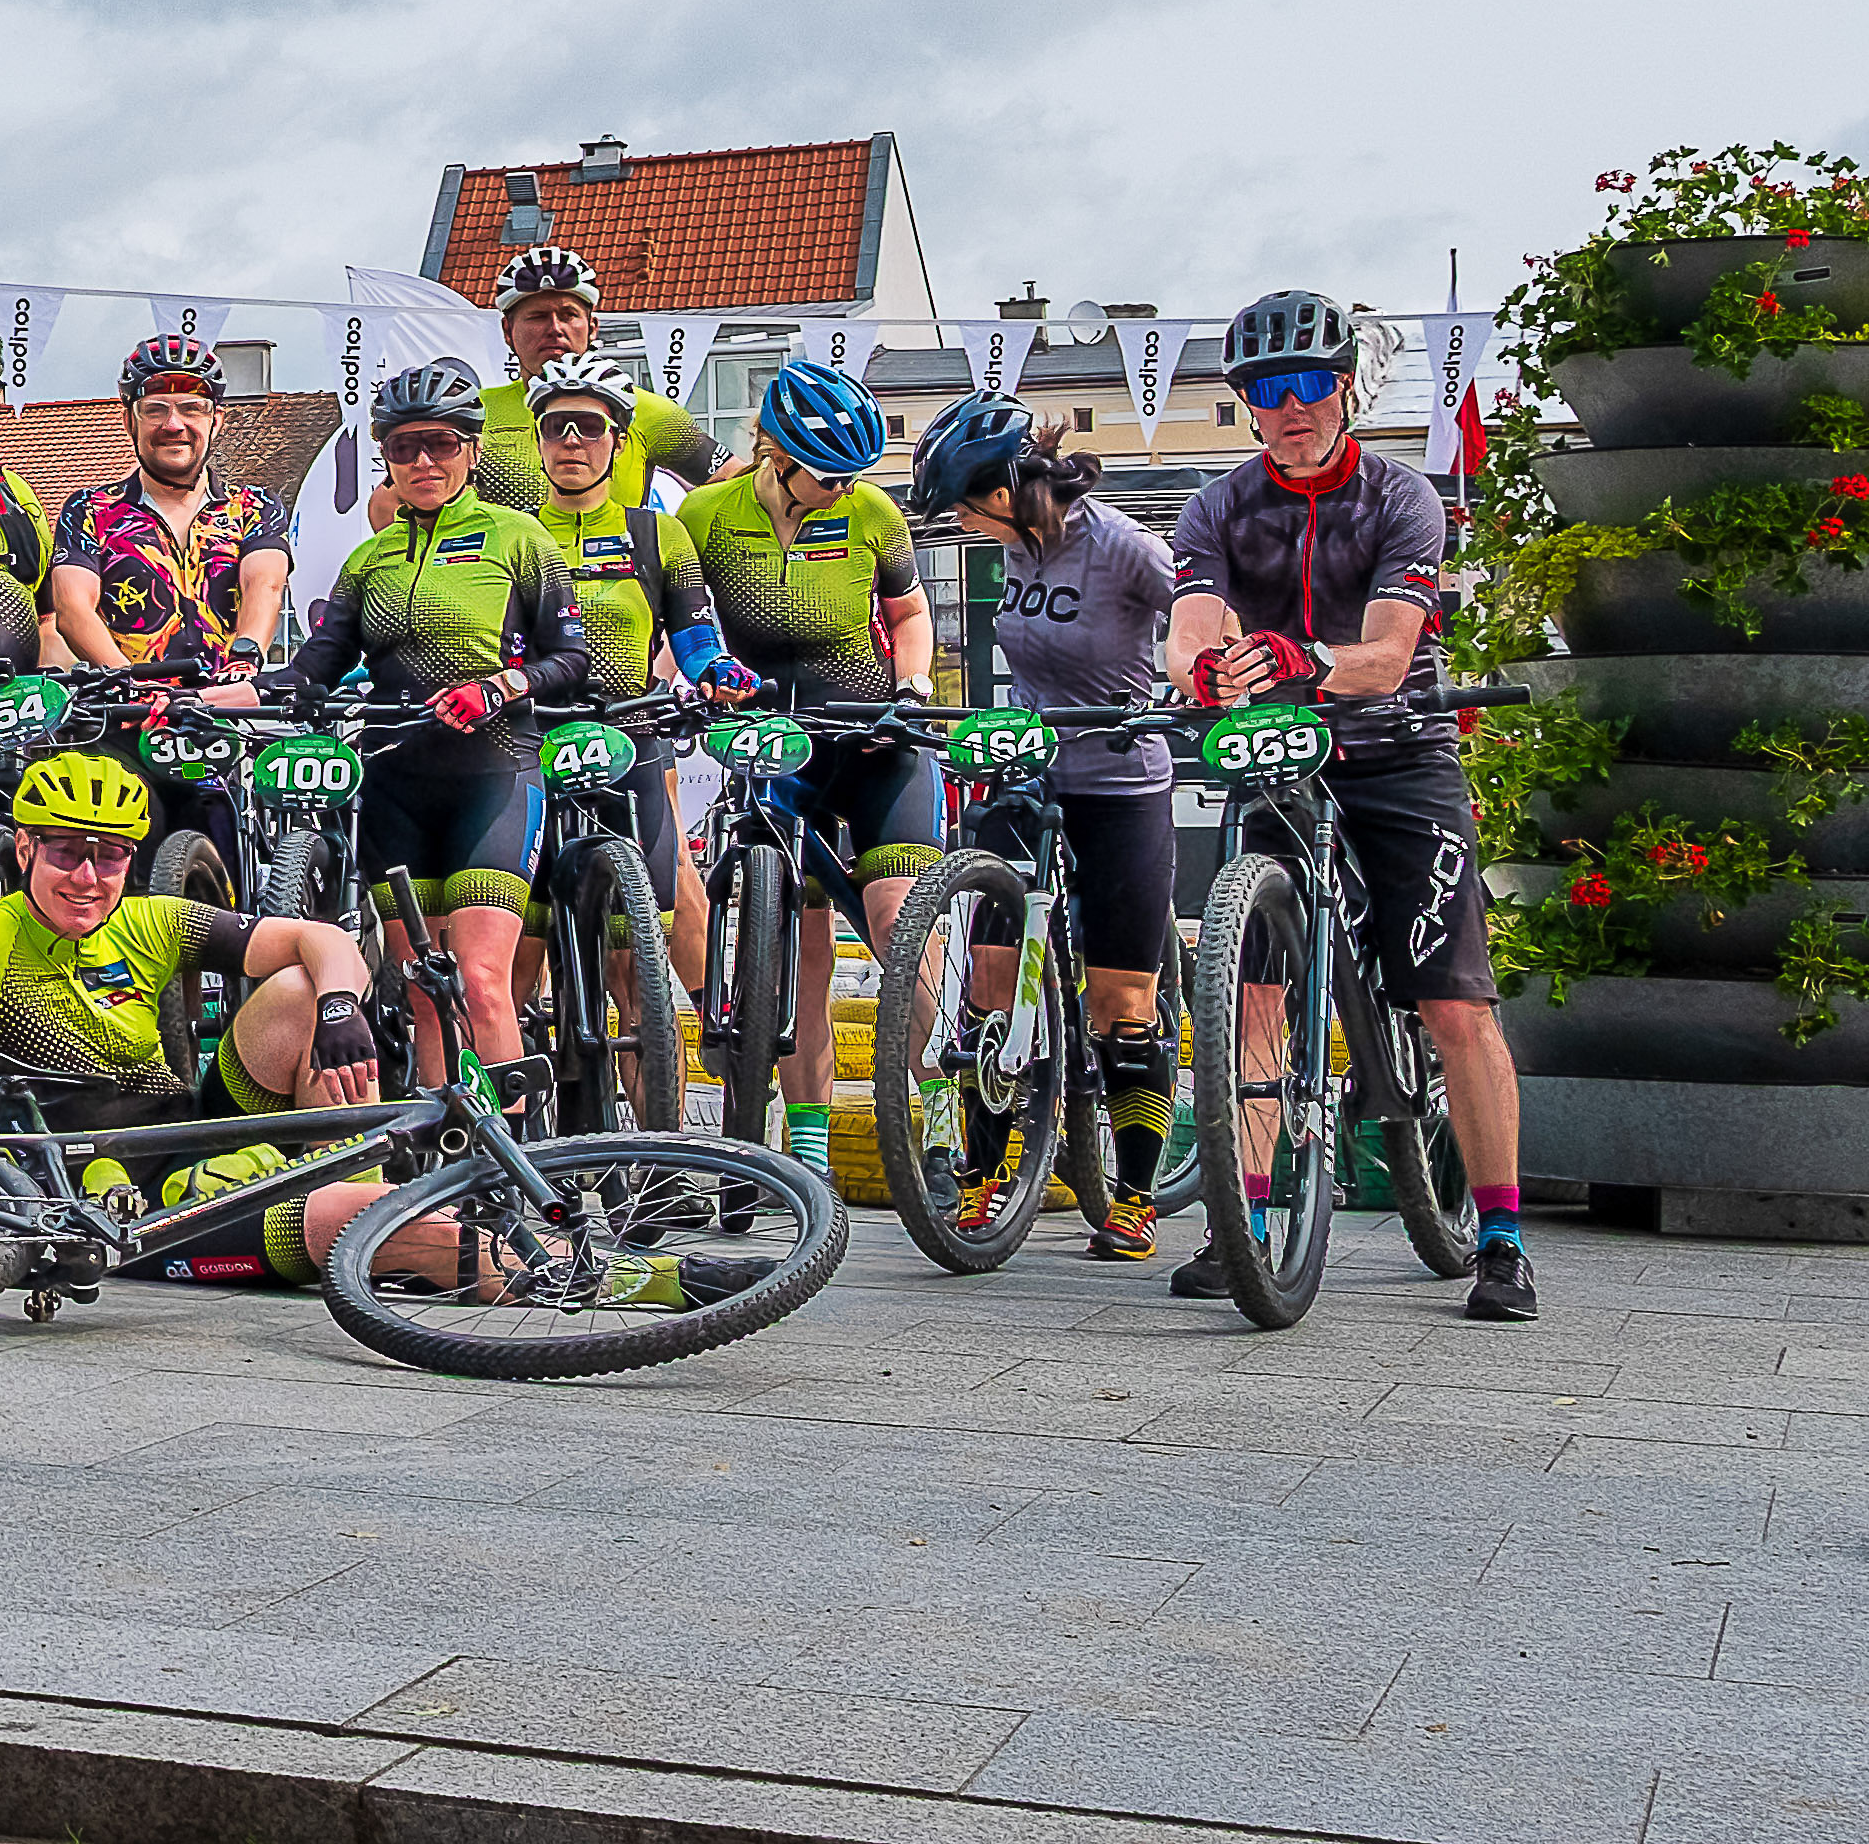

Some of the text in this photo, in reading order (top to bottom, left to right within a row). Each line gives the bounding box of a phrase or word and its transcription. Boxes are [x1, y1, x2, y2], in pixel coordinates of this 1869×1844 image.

[553, 738, 612, 774] 44
[731, 728, 784, 760] 41
[265, 757, 352, 791] 100
[198, 1261, 255, 1276] GORDON
